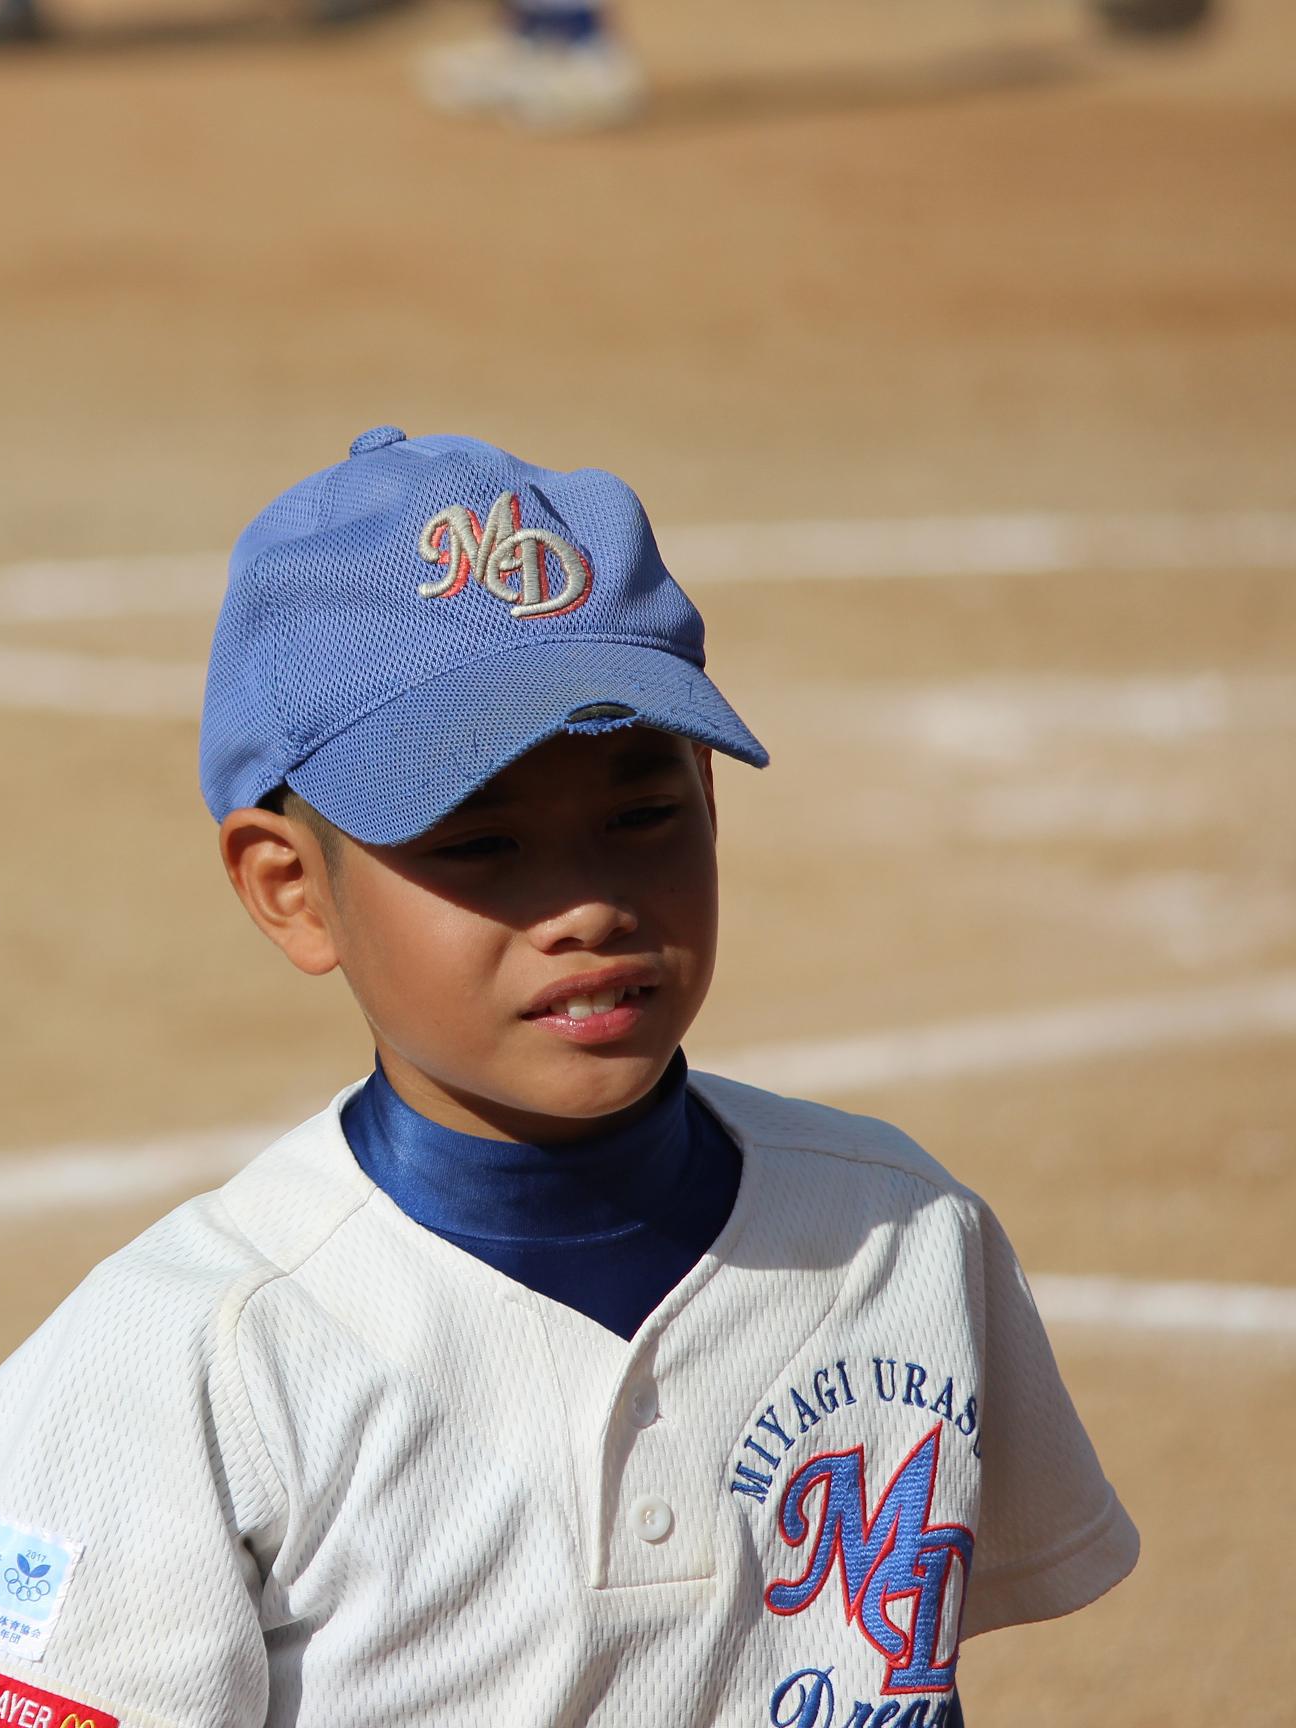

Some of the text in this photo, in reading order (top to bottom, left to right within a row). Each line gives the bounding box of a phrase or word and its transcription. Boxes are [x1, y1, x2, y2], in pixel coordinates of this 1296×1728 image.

[730, 1357, 982, 1504] MIYAGI URAS
[25, 1549, 47, 1563] 2017
